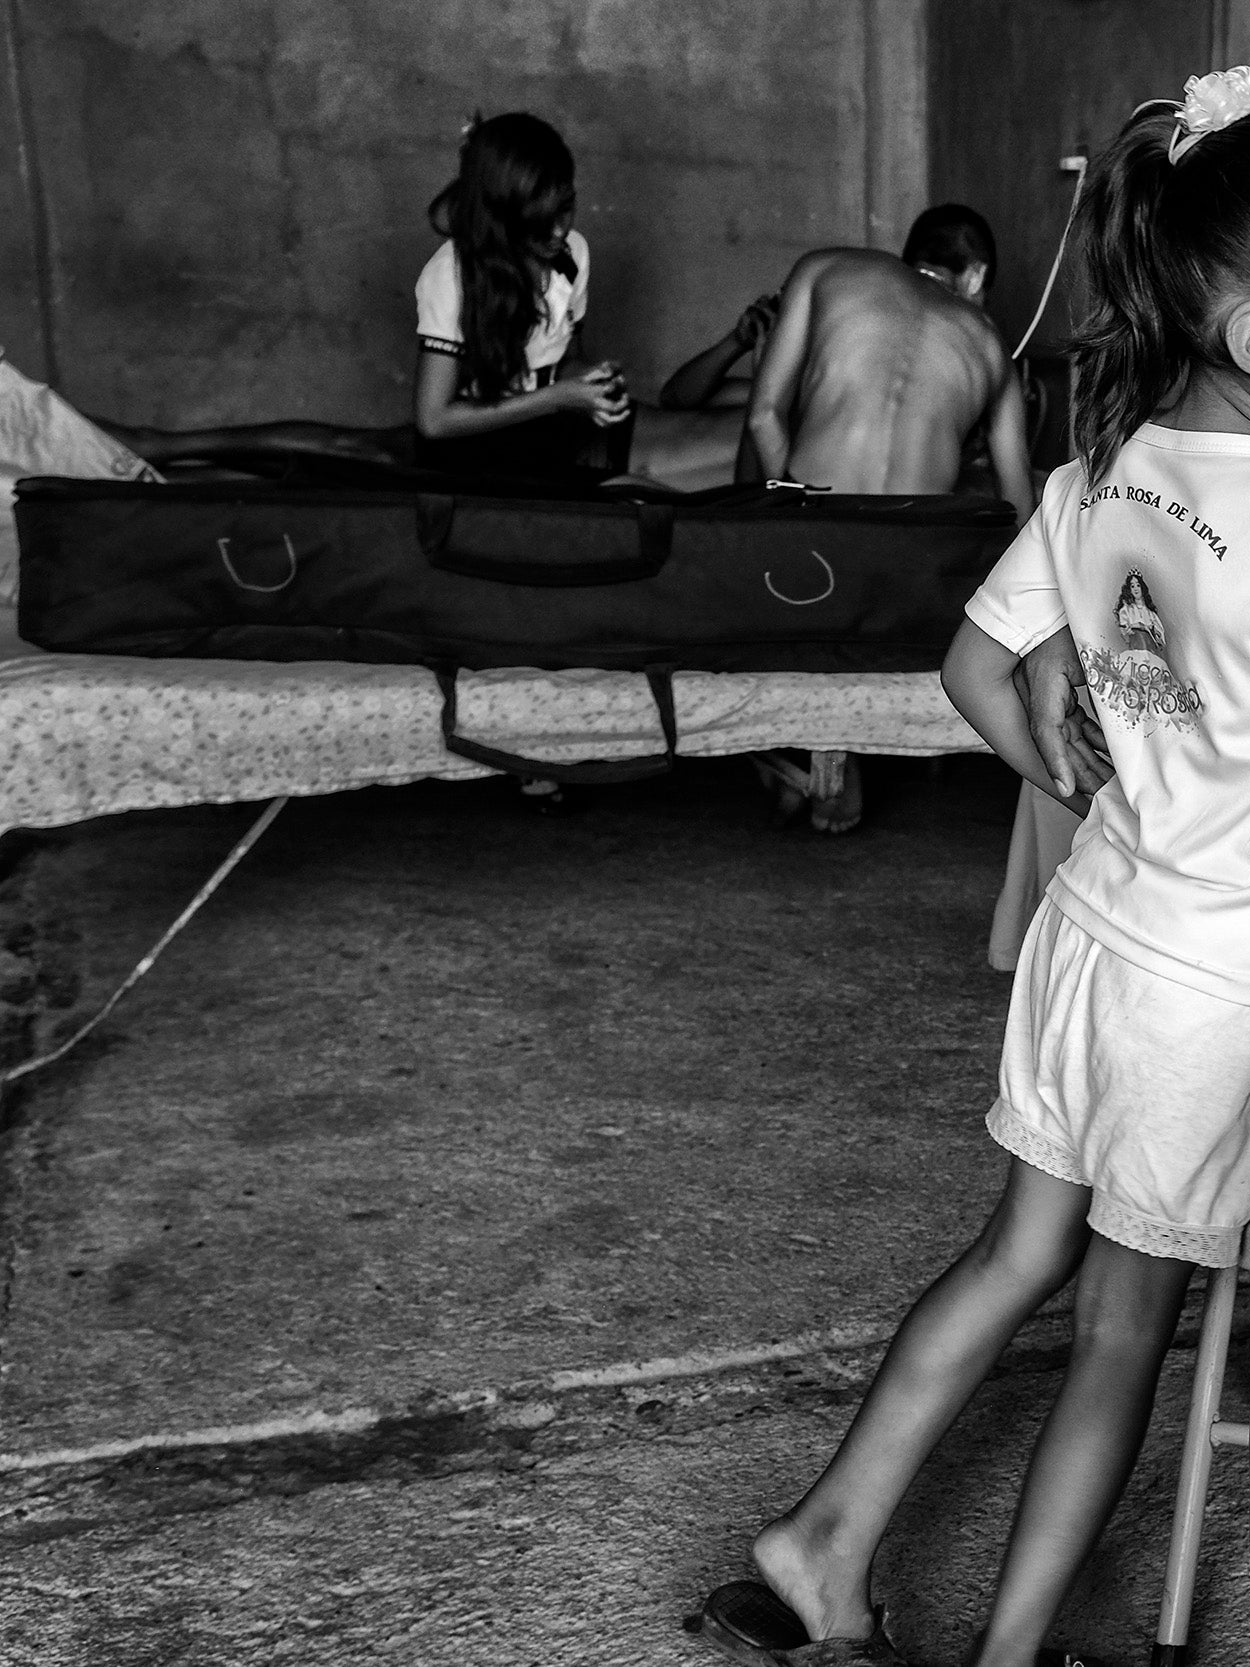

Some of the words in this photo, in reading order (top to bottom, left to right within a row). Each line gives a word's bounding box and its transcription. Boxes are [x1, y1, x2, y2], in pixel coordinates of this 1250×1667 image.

[1080, 485, 1121, 511] SANTA
[1126, 486, 1162, 509] ROSA
[1166, 501, 1189, 522] DE
[1189, 516, 1228, 562] LIMA
